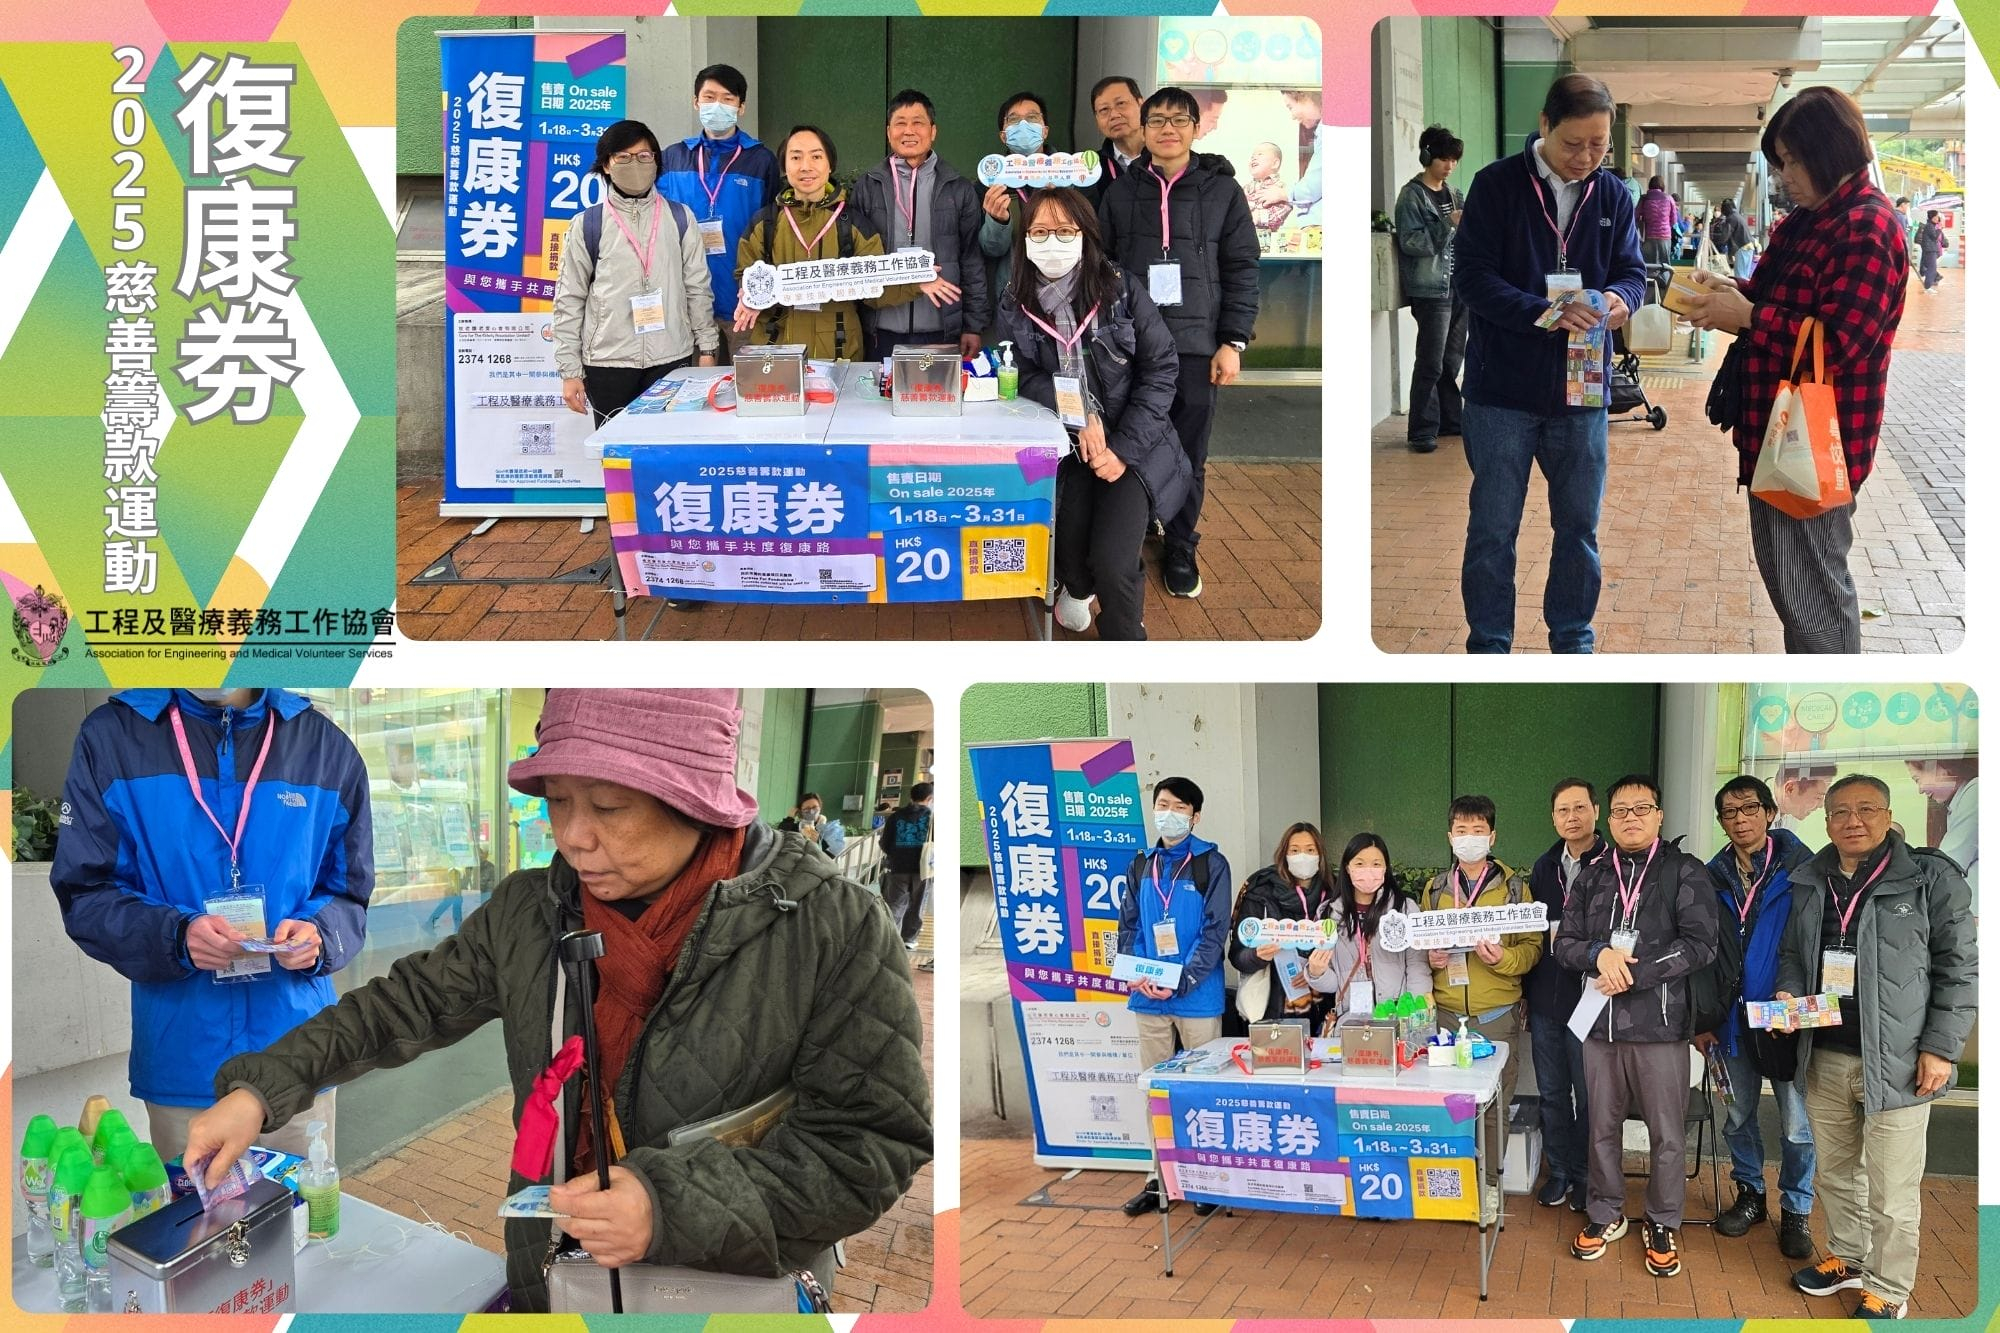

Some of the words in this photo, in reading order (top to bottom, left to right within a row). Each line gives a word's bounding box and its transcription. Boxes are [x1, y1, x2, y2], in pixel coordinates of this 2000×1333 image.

[541, 83, 565, 95] 售賣
[569, 85, 588, 96] On
[591, 86, 617, 97] sale
[541, 97, 564, 109] 日期
[569, 99, 611, 111] 2025年
[460, 71, 525, 258] 復康券
[554, 153, 581, 167] HK$
[551, 170, 605, 209] 20
[781, 254, 931, 281] 工程及醫療義務工作協會
[782, 283, 812, 292] Association
[822, 280, 852, 290] Engineering
[865, 277, 885, 285] Medical
[887, 275, 910, 283] Volunteer
[911, 273, 934, 281] Services
[458, 354, 484, 364] 2374
[487, 354, 512, 364] 1268
[699, 465, 807, 478] 2025慈善籌款運動
[886, 472, 942, 485] 售賣日期
[889, 488, 909, 498] On
[913, 487, 944, 498] sale
[948, 487, 995, 497] 2025年
[653, 481, 845, 535] 復康券
[895, 536, 922, 548] HK$
[896, 548, 950, 583] 20
[646, 575, 664, 583] 2374
[1088, 792, 1106, 805] On
[1107, 794, 1133, 805] sale
[1065, 805, 1086, 817] 日期
[1089, 806, 1129, 818] 2025年
[999, 781, 1065, 955] 復康券
[1083, 858, 1108, 871] HK$
[1411, 906, 1544, 928] 工程及醫療義務工作協會
[1031, 1036, 1052, 1045] 2374
[1055, 1036, 1075, 1045] 1268
[1184, 1108, 1320, 1156] 復康券
[1352, 1122, 1368, 1131] On
[1370, 1122, 1392, 1131] sale
[1395, 1123, 1431, 1133] 2025年
[1359, 1163, 1380, 1172] HK$
[1360, 1173, 1403, 1200] 20
